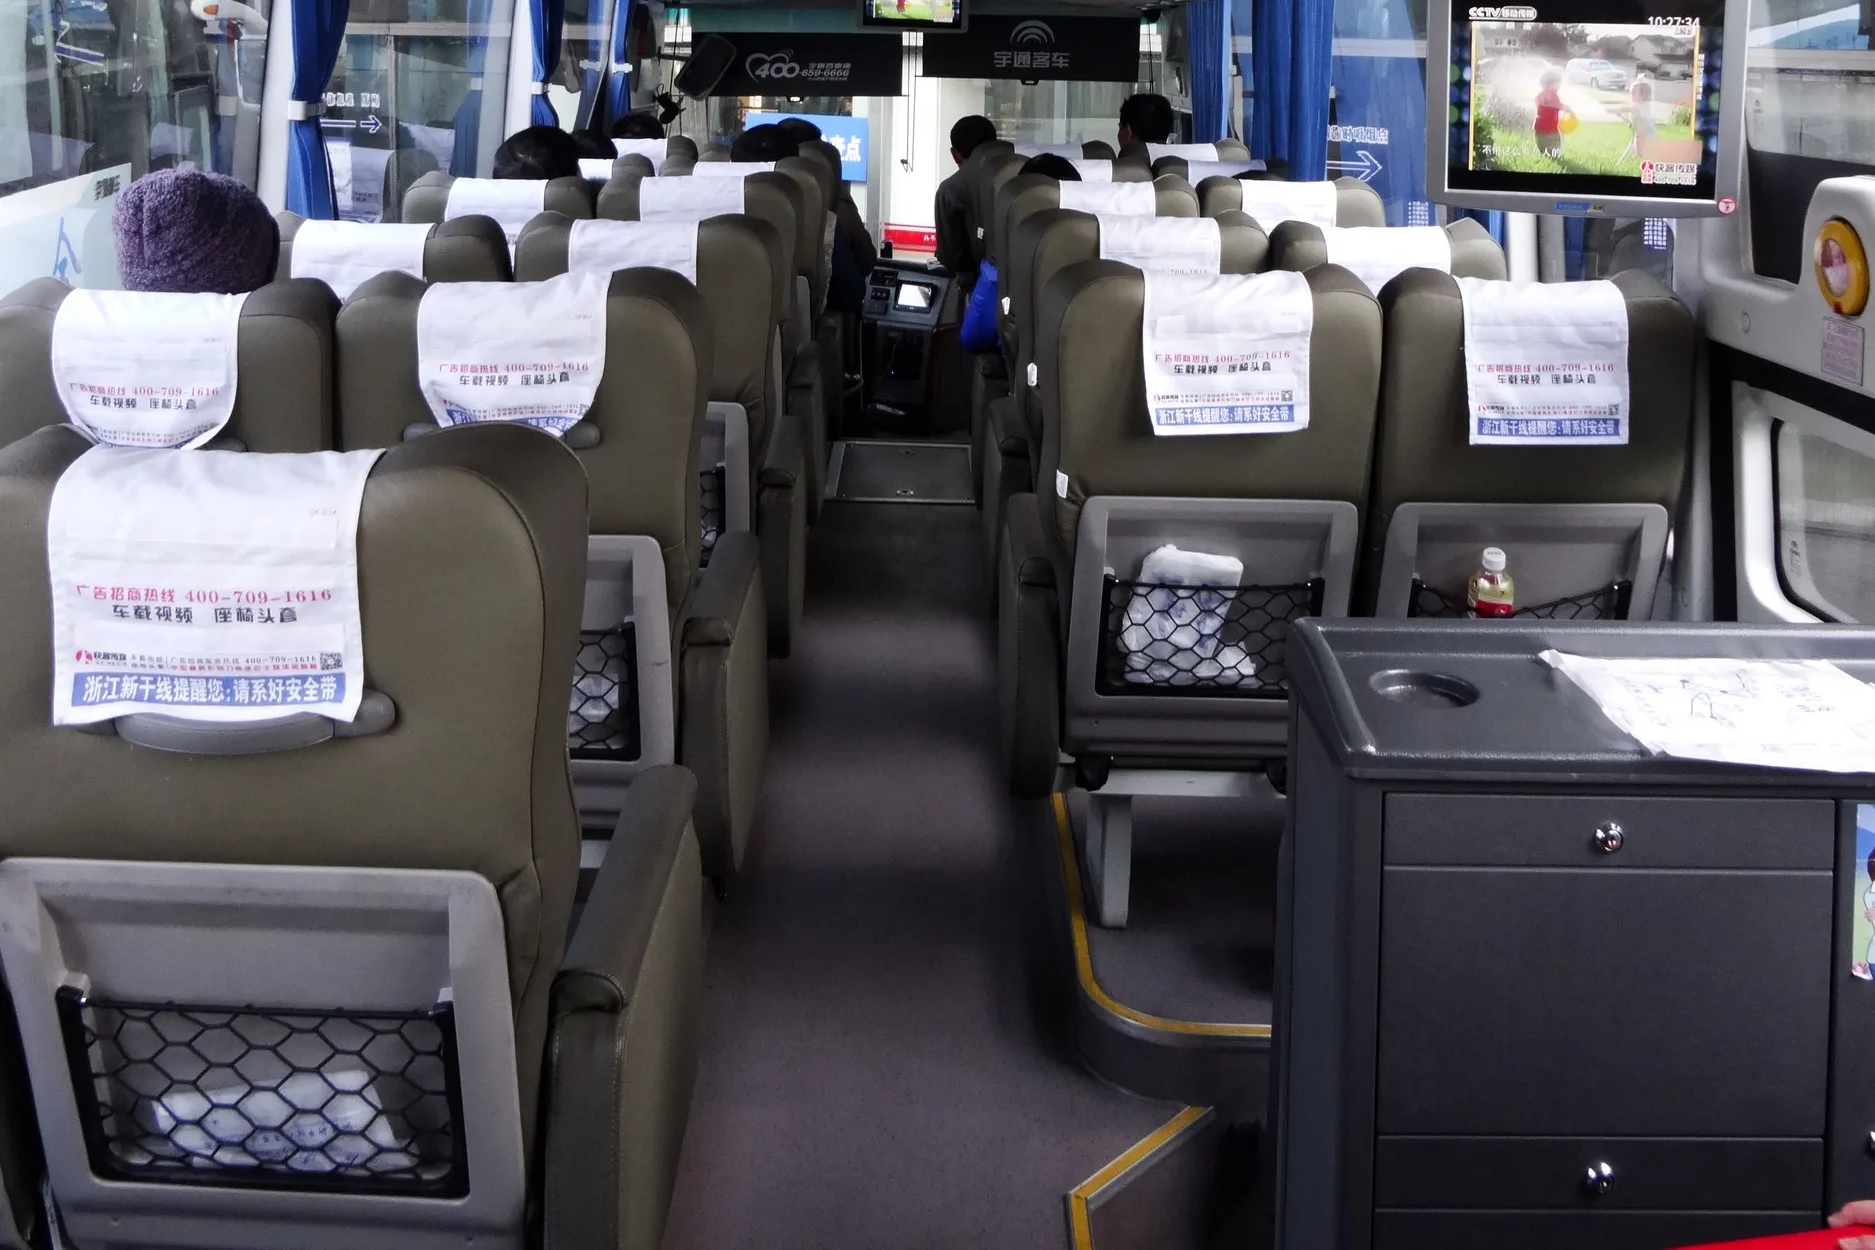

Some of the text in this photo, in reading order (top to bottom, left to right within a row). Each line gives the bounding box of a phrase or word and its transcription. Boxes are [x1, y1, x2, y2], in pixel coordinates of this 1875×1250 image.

[1469, 7, 1500, 18] CCTV
[1648, 17, 1700, 29] 10:27:34
[994, 51, 1069, 68] 宇通客车
[1155, 351, 1290, 363] 广告招商热线 400-709-1616
[440, 362, 588, 374] 广告招商热线 400-709-1616
[1174, 362, 1271, 374] 车载视频 座椅头套
[1478, 364, 1613, 373] 广告招商热线 400-709-1616
[459, 372, 570, 386] 车载视频 座椅头套
[1498, 374, 1596, 384] 车载视频 座椅头套
[70, 383, 219, 397] 广告招商热线 400-709-1616
[90, 395, 196, 411] 车载视频 座椅头套
[76, 584, 331, 604] 广告招商热线 400-709-1616
[113, 604, 297, 624] 车载视频 座椅头套
